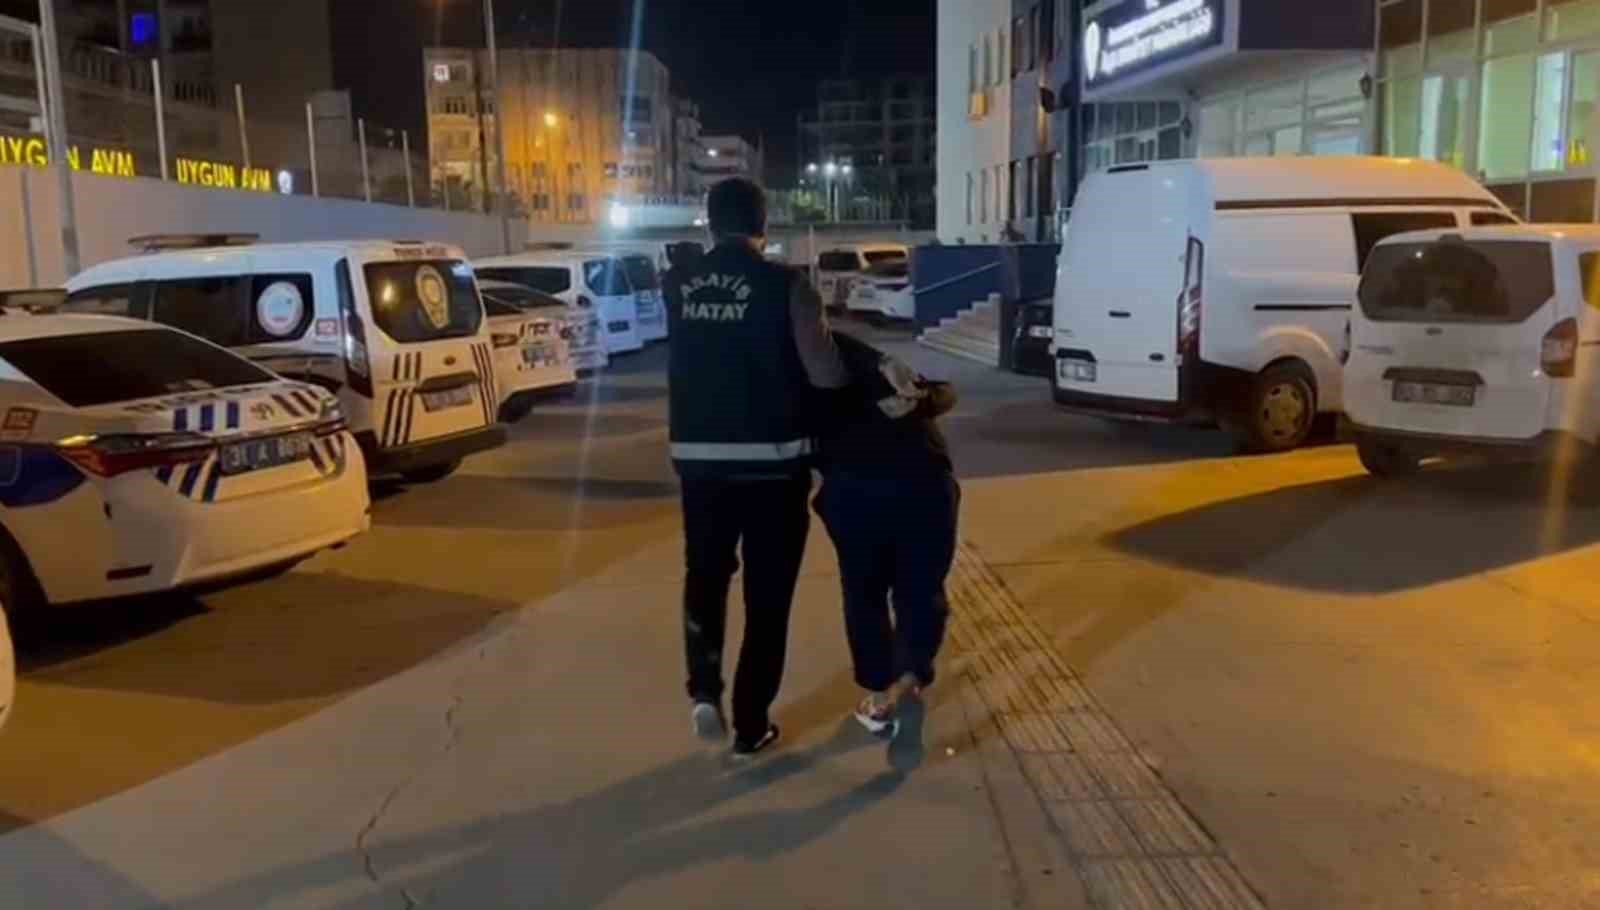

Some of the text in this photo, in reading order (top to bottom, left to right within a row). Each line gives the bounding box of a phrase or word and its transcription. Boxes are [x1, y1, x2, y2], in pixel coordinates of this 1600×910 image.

[91, 148, 135, 177] AVM
[176, 158, 235, 189] UYGUN
[682, 302, 749, 320] HATAY
